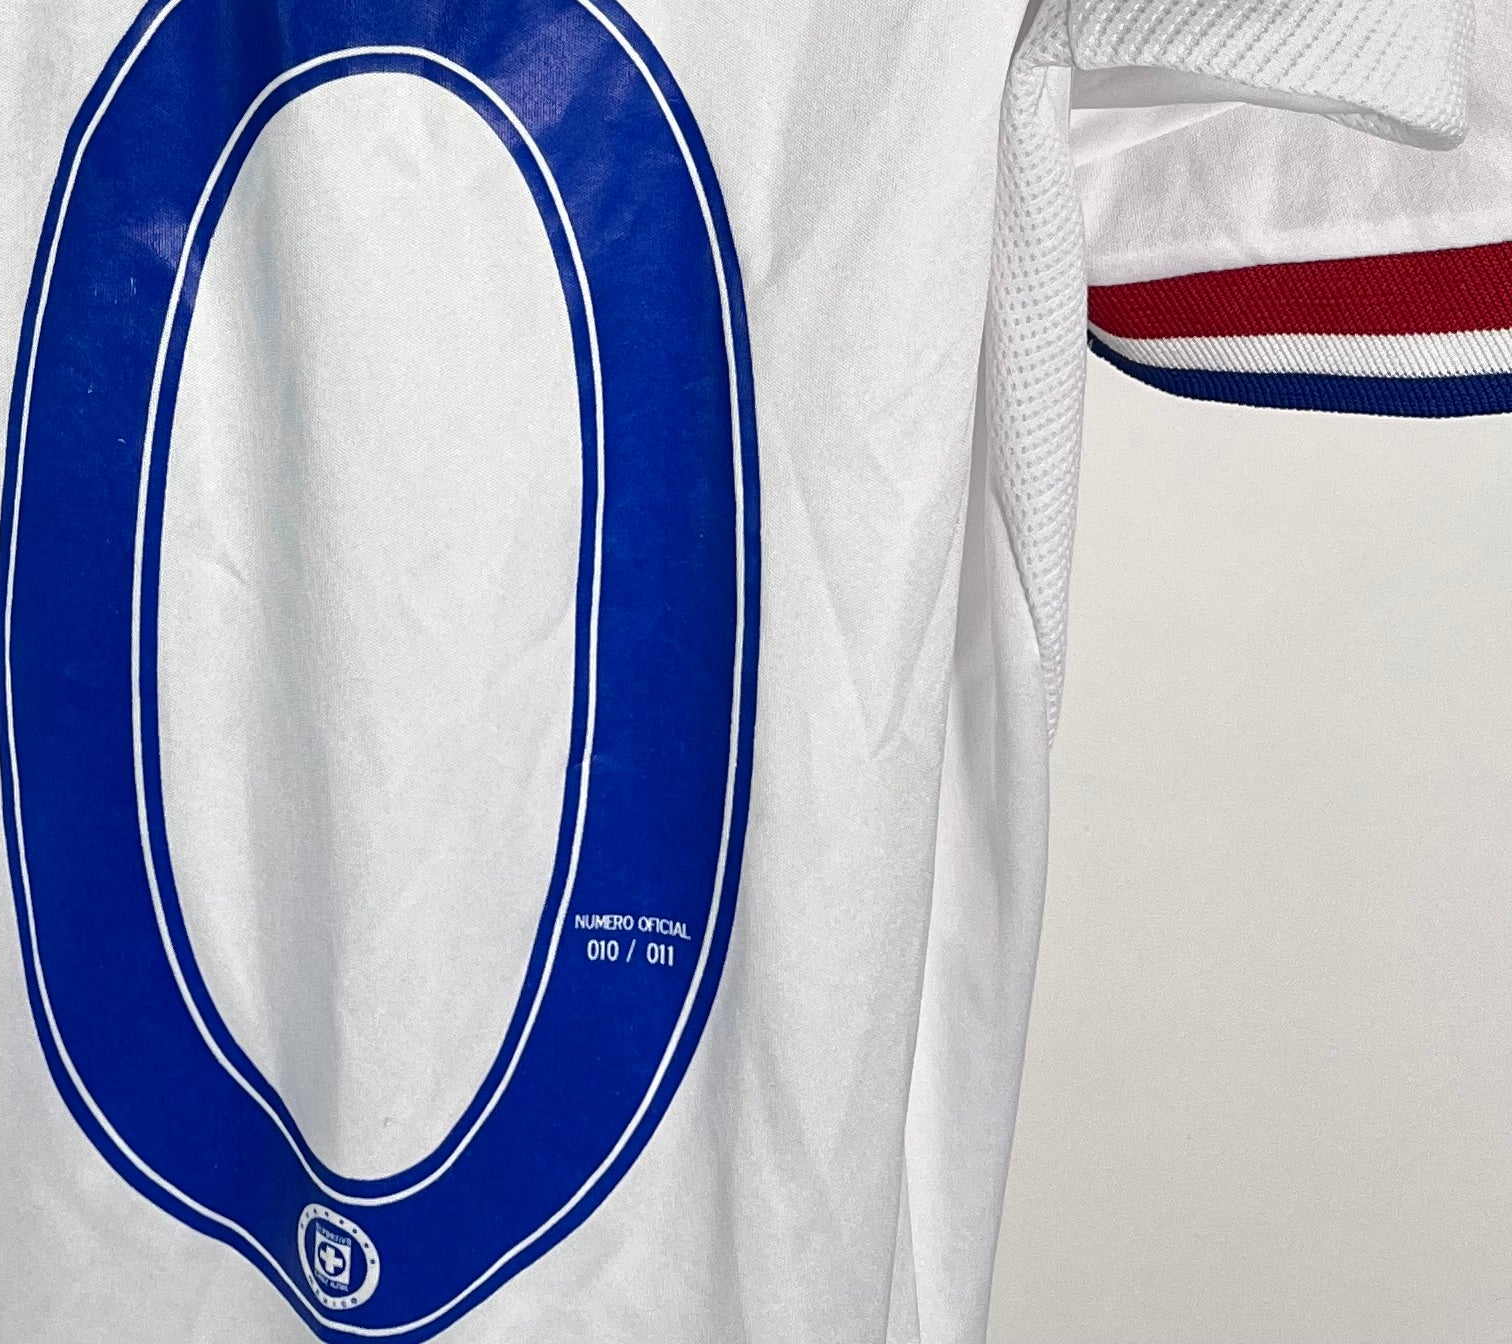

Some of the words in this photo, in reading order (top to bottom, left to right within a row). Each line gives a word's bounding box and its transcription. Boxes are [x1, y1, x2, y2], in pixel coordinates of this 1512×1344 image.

[574, 913, 634, 931] NUMERO
[637, 916, 692, 940] OFICIAL
[587, 939, 620, 962] 010
[646, 942, 675, 967] 011
